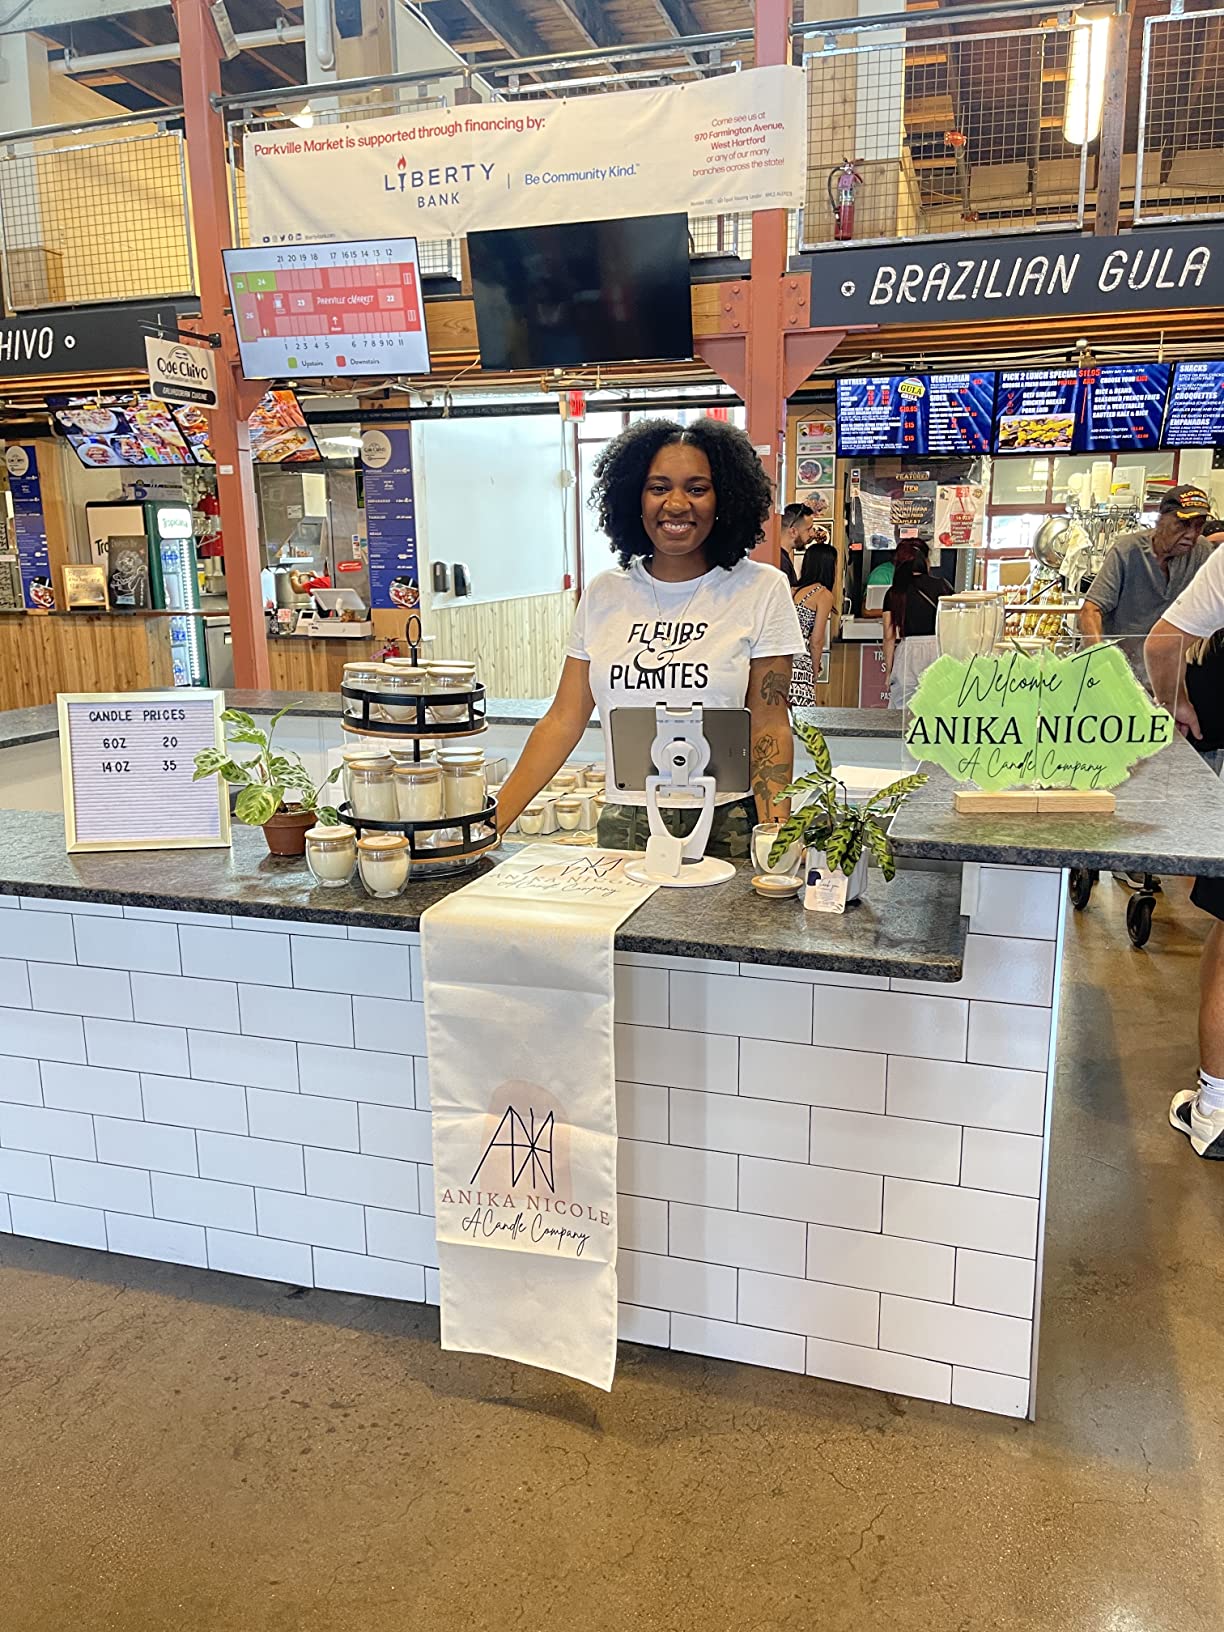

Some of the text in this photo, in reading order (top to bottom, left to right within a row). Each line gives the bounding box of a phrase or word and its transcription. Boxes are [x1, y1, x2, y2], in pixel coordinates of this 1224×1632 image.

[711, 117, 733, 127] Come
[734, 114, 747, 123] see
[254, 116, 546, 156] Parkville Market is supported through financing by:
[694, 121, 785, 142] 970 Farmington Avenue,
[711, 135, 766, 150] West Hartford
[715, 154, 728, 163] any
[729, 151, 737, 160] of
[750, 147, 770, 156] many
[692, 166, 726, 176] branches
[726, 162, 750, 172] across
[751, 160, 763, 168] the
[384, 163, 496, 193] LIBERTY
[524, 173, 541, 186] Be
[542, 167, 608, 184] Community
[417, 192, 461, 209] BANK
[287, 254, 297, 262] 20
[300, 253, 307, 261] 19
[310, 253, 318, 261] 18
[342, 251, 349, 259] 16
[350, 250, 357, 258] 15
[373, 249, 380, 257] 13
[385, 248, 393, 256] 12
[257, 278, 266, 286] 24
[869, 246, 1211, 305] BRAZILIAN GULA
[301, 357, 380, 367] Upstairs Downstairs
[1180, 364, 1207, 372] SNACKS
[179, 361, 208, 380] Chivo
[1002, 373, 1020, 381] PICK
[1019, 372, 1026, 380] 2
[1026, 370, 1049, 380] LUNCH
[1049, 369, 1077, 379] SPECIAL
[900, 384, 922, 395] GULA
[1175, 391, 1218, 400] CROQUETTES
[1170, 418, 1211, 426] EMPANADAS
[627, 621, 709, 647] FLEURS
[610, 663, 709, 689] PLANTES
[957, 638, 1126, 713] Welcome To
[89, 709, 186, 722] CANDLE PRICES
[906, 715, 1170, 745] ANIKA NICOLE
[162, 736, 178, 748] 20
[162, 760, 177, 771] 35
[958, 746, 1108, 788] A Candle Company
[442, 1189, 611, 1226] ANIKA NICOLE
[462, 1207, 591, 1257] A Candle Company
